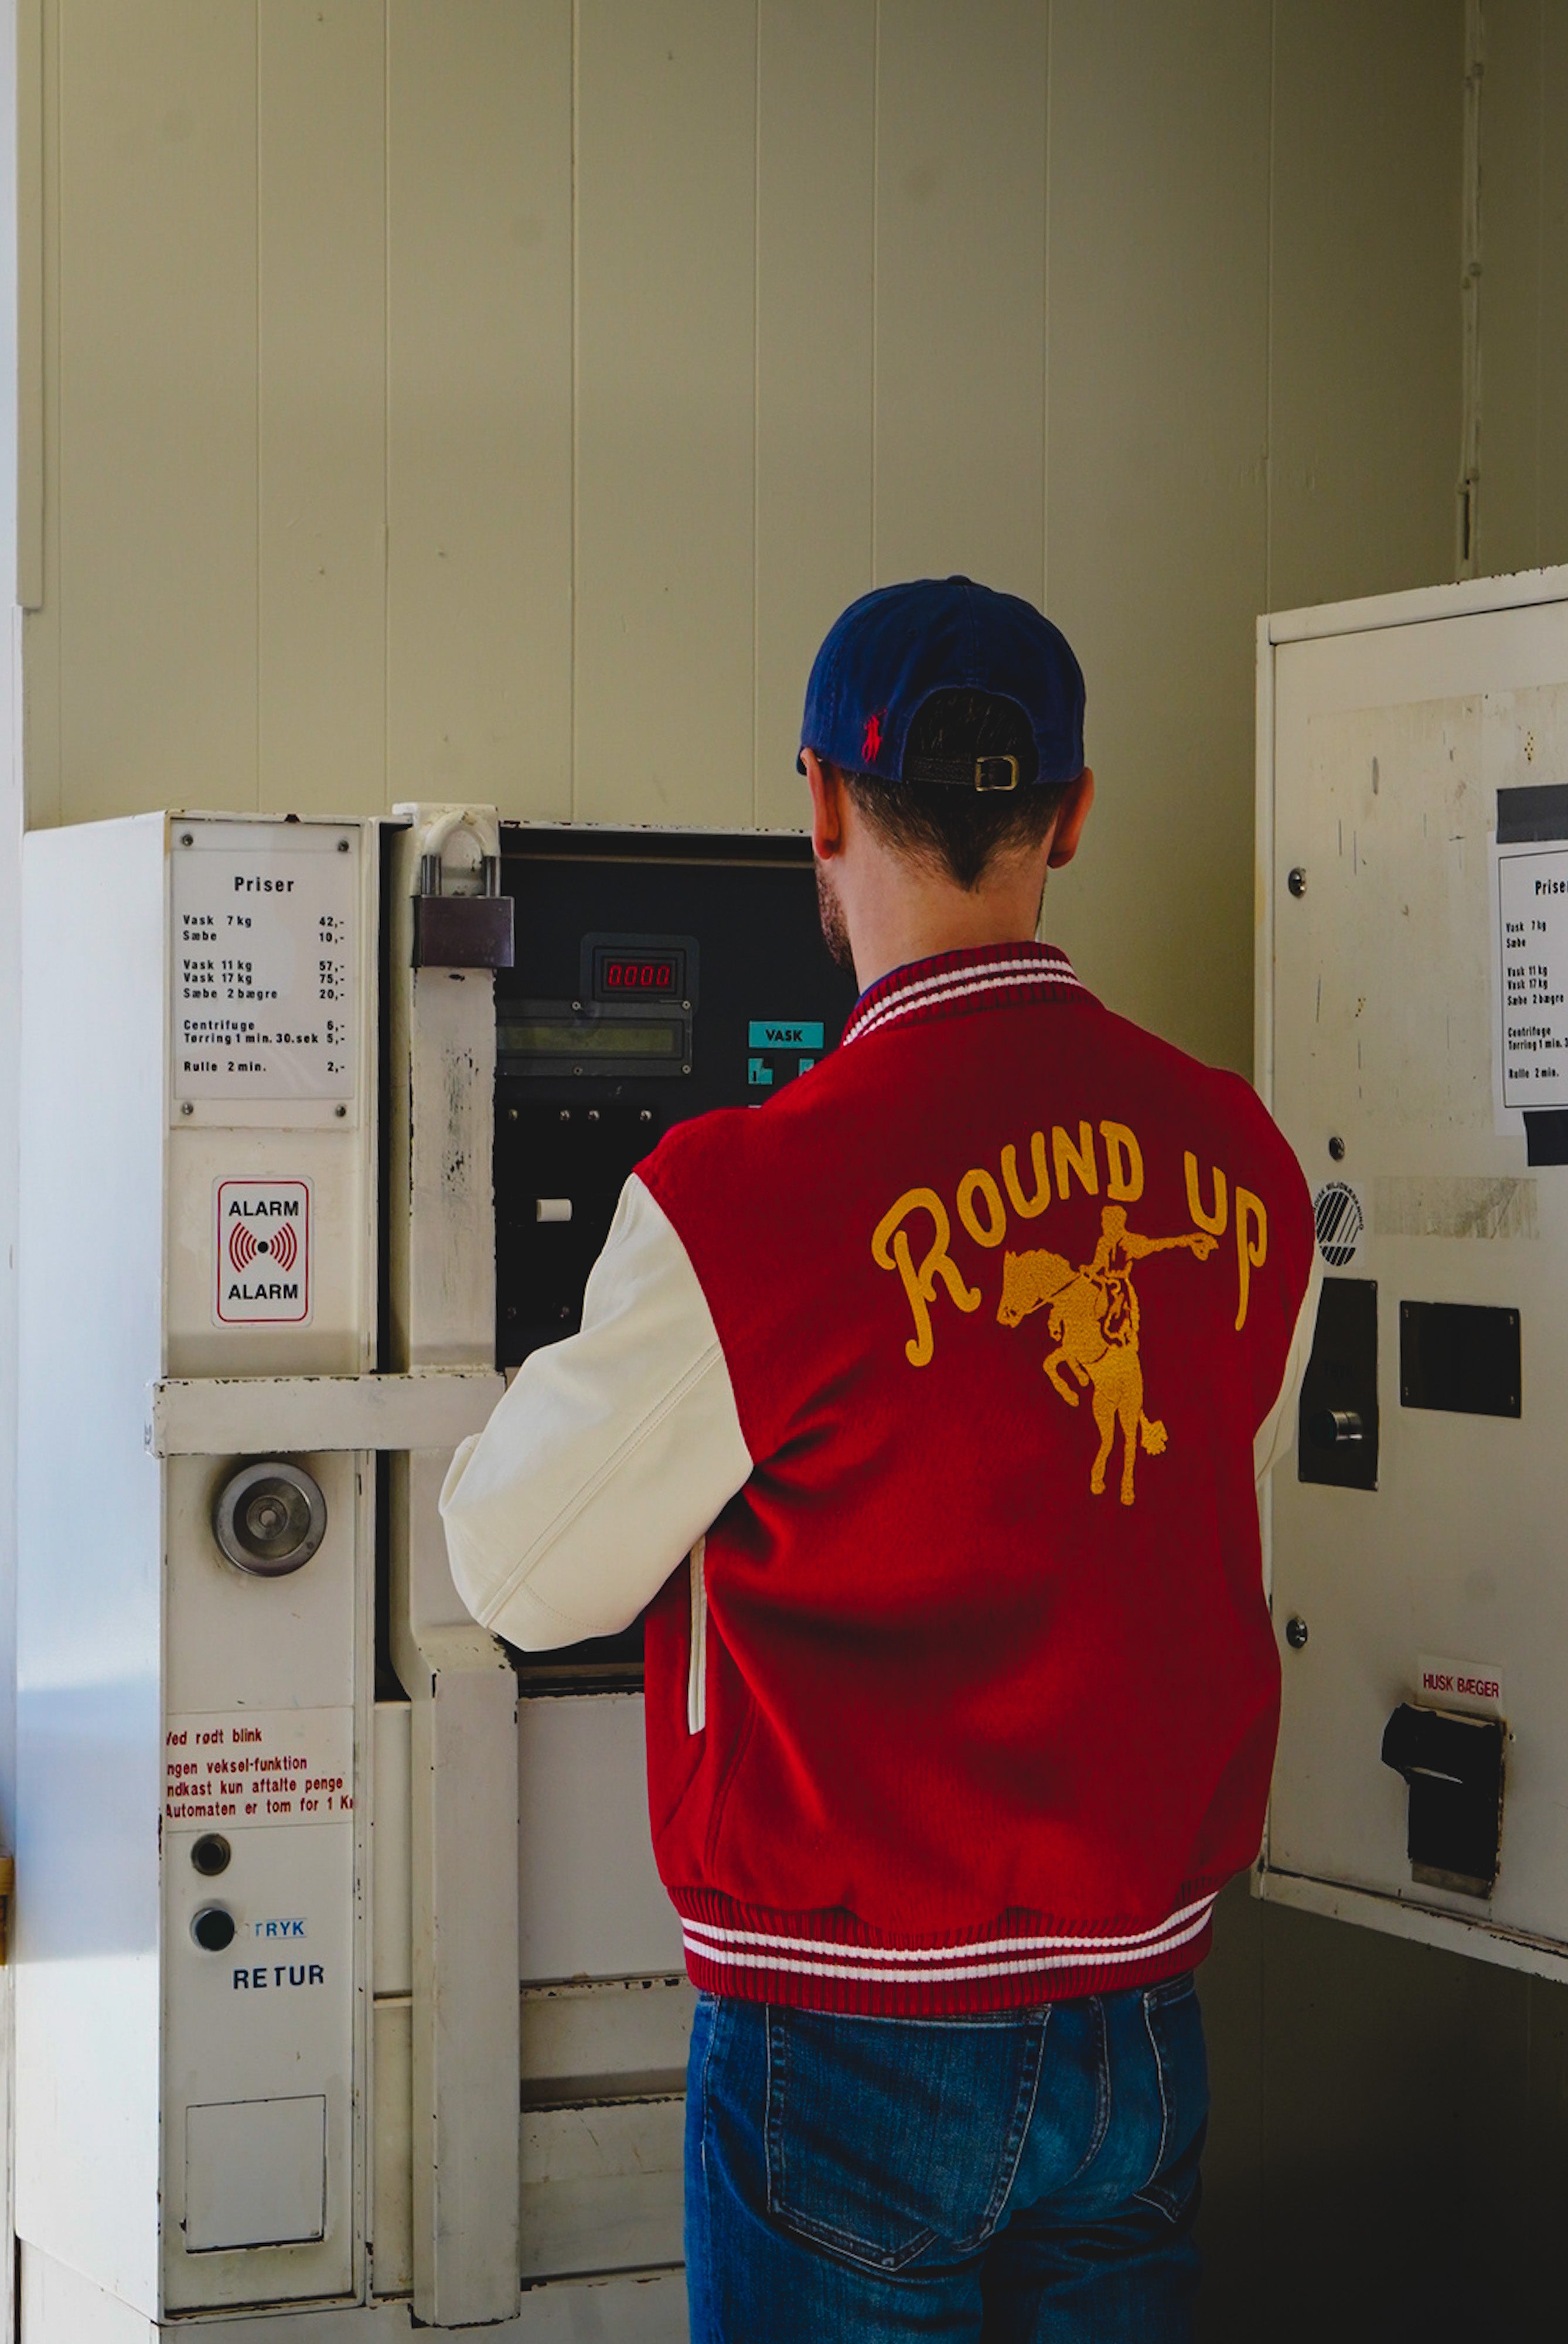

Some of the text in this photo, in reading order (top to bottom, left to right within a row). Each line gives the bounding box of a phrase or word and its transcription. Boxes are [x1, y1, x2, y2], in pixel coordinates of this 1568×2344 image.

[234, 877, 294, 892] Priser
[183, 915, 344, 928] Vask 7 kg 42,-
[183, 930, 344, 944] Sæbe 10,-
[183, 959, 344, 973] Vask 11 kg 57,-
[183, 973, 345, 985] Vask 17 kg 75,-
[183, 988, 344, 1001] Sæbe 2 bægre 20,-
[184, 1020, 345, 1032] Centrifuge 6,-
[185, 1033, 231, 1045] Tørring
[236, 1034, 240, 1043] 1
[246, 1033, 272, 1043] min.
[327, 1033, 345, 1045] 5,-
[765, 1029, 803, 1042] VASK
[184, 1061, 345, 1073] Rulle 2 min. 2,-
[229, 1201, 299, 1216] ALARM
[871, 1120, 1267, 1367] ROUND UP
[228, 1284, 298, 1299] ALARM
[1423, 1673, 1499, 1698] HUSK BÆGER
[196, 1729, 223, 1745] rødt
[233, 1728, 262, 1743] blink
[167, 1756, 307, 1779] ngen veksel-funktion
[167, 1777, 343, 1797] ndkast kun aftalte penge
[166, 1800, 236, 1818] Automaten
[245, 1802, 257, 1815] er
[267, 1798, 291, 1814] tom
[300, 1797, 319, 1812] for
[328, 1796, 332, 1811] 1
[255, 1921, 304, 1937] TRYK
[233, 1964, 324, 1989] RETUR
